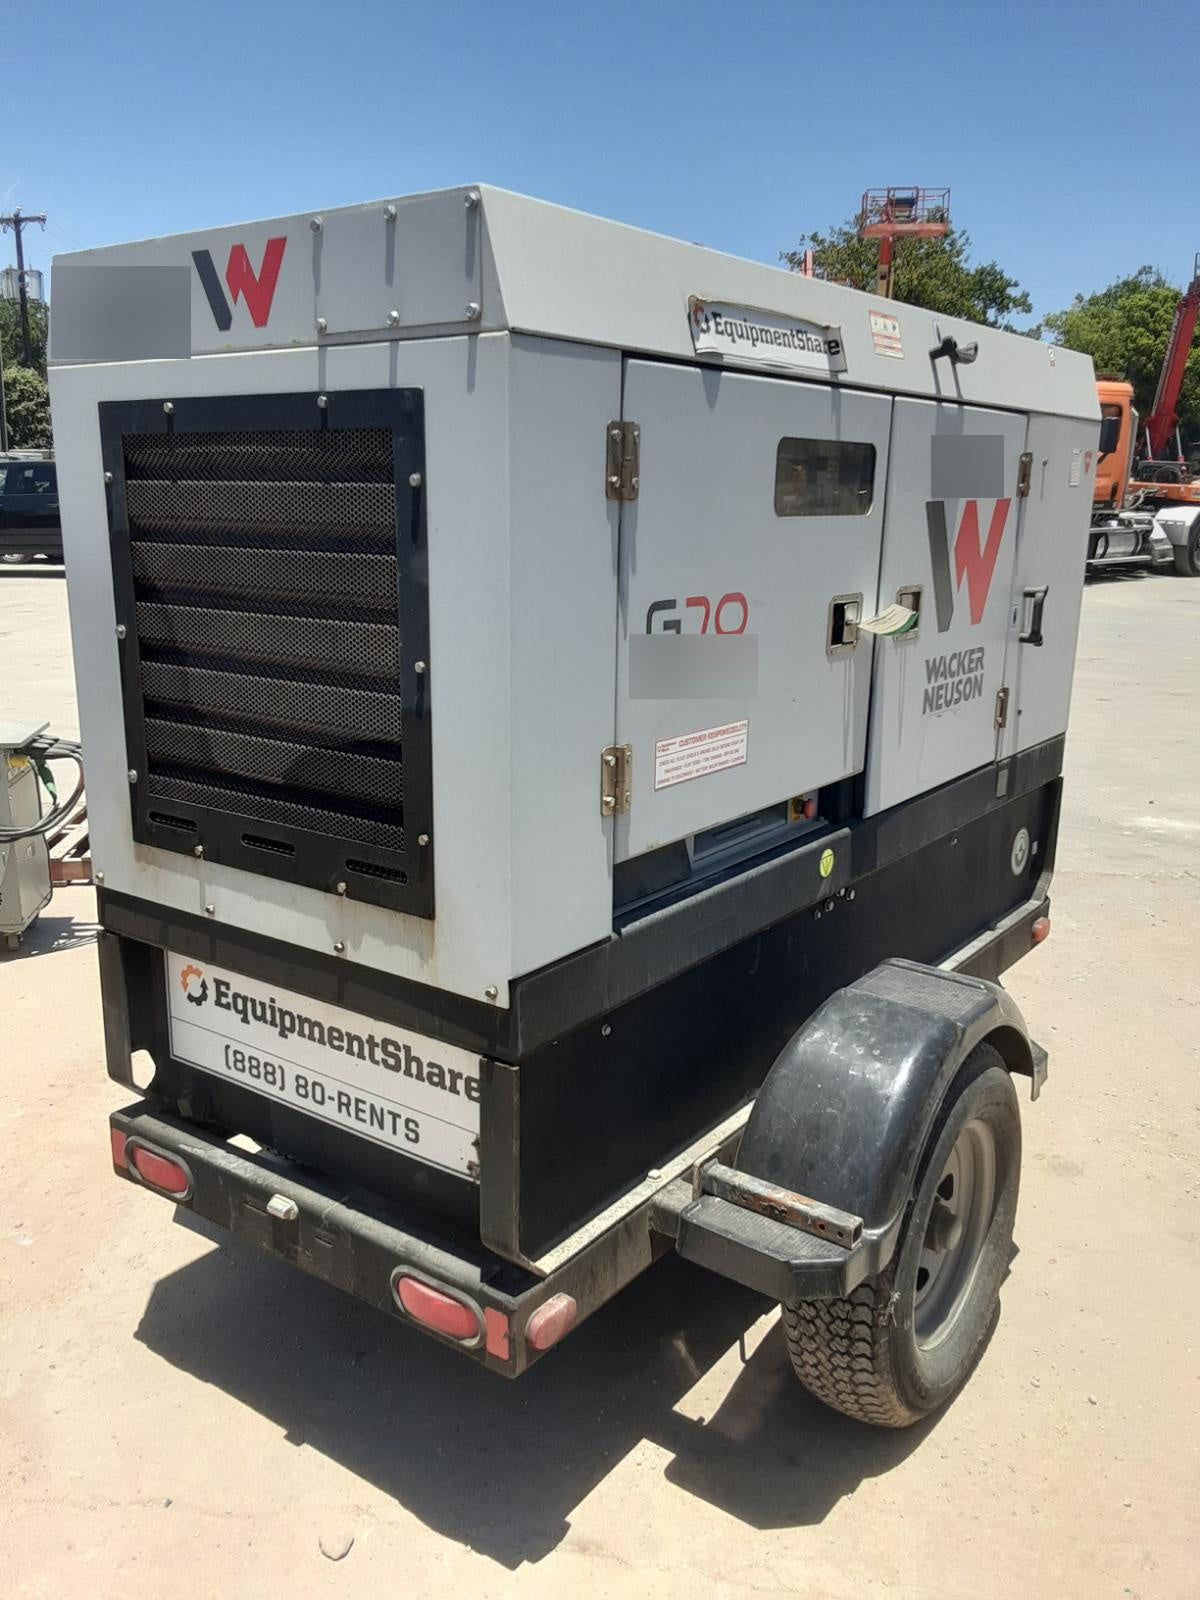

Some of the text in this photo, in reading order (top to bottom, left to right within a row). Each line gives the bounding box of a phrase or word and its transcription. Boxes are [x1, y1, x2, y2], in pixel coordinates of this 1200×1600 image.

[711, 311, 840, 356] EquipmentShare
[646, 592, 748, 634] G70
[925, 647, 985, 684] WACKER
[922, 672, 984, 715] NEUSON
[678, 733, 707, 747] CUSTOMER
[213, 977, 481, 1103] EquipmentShare
[224, 1044, 420, 1145] (888) 80-RENTS
